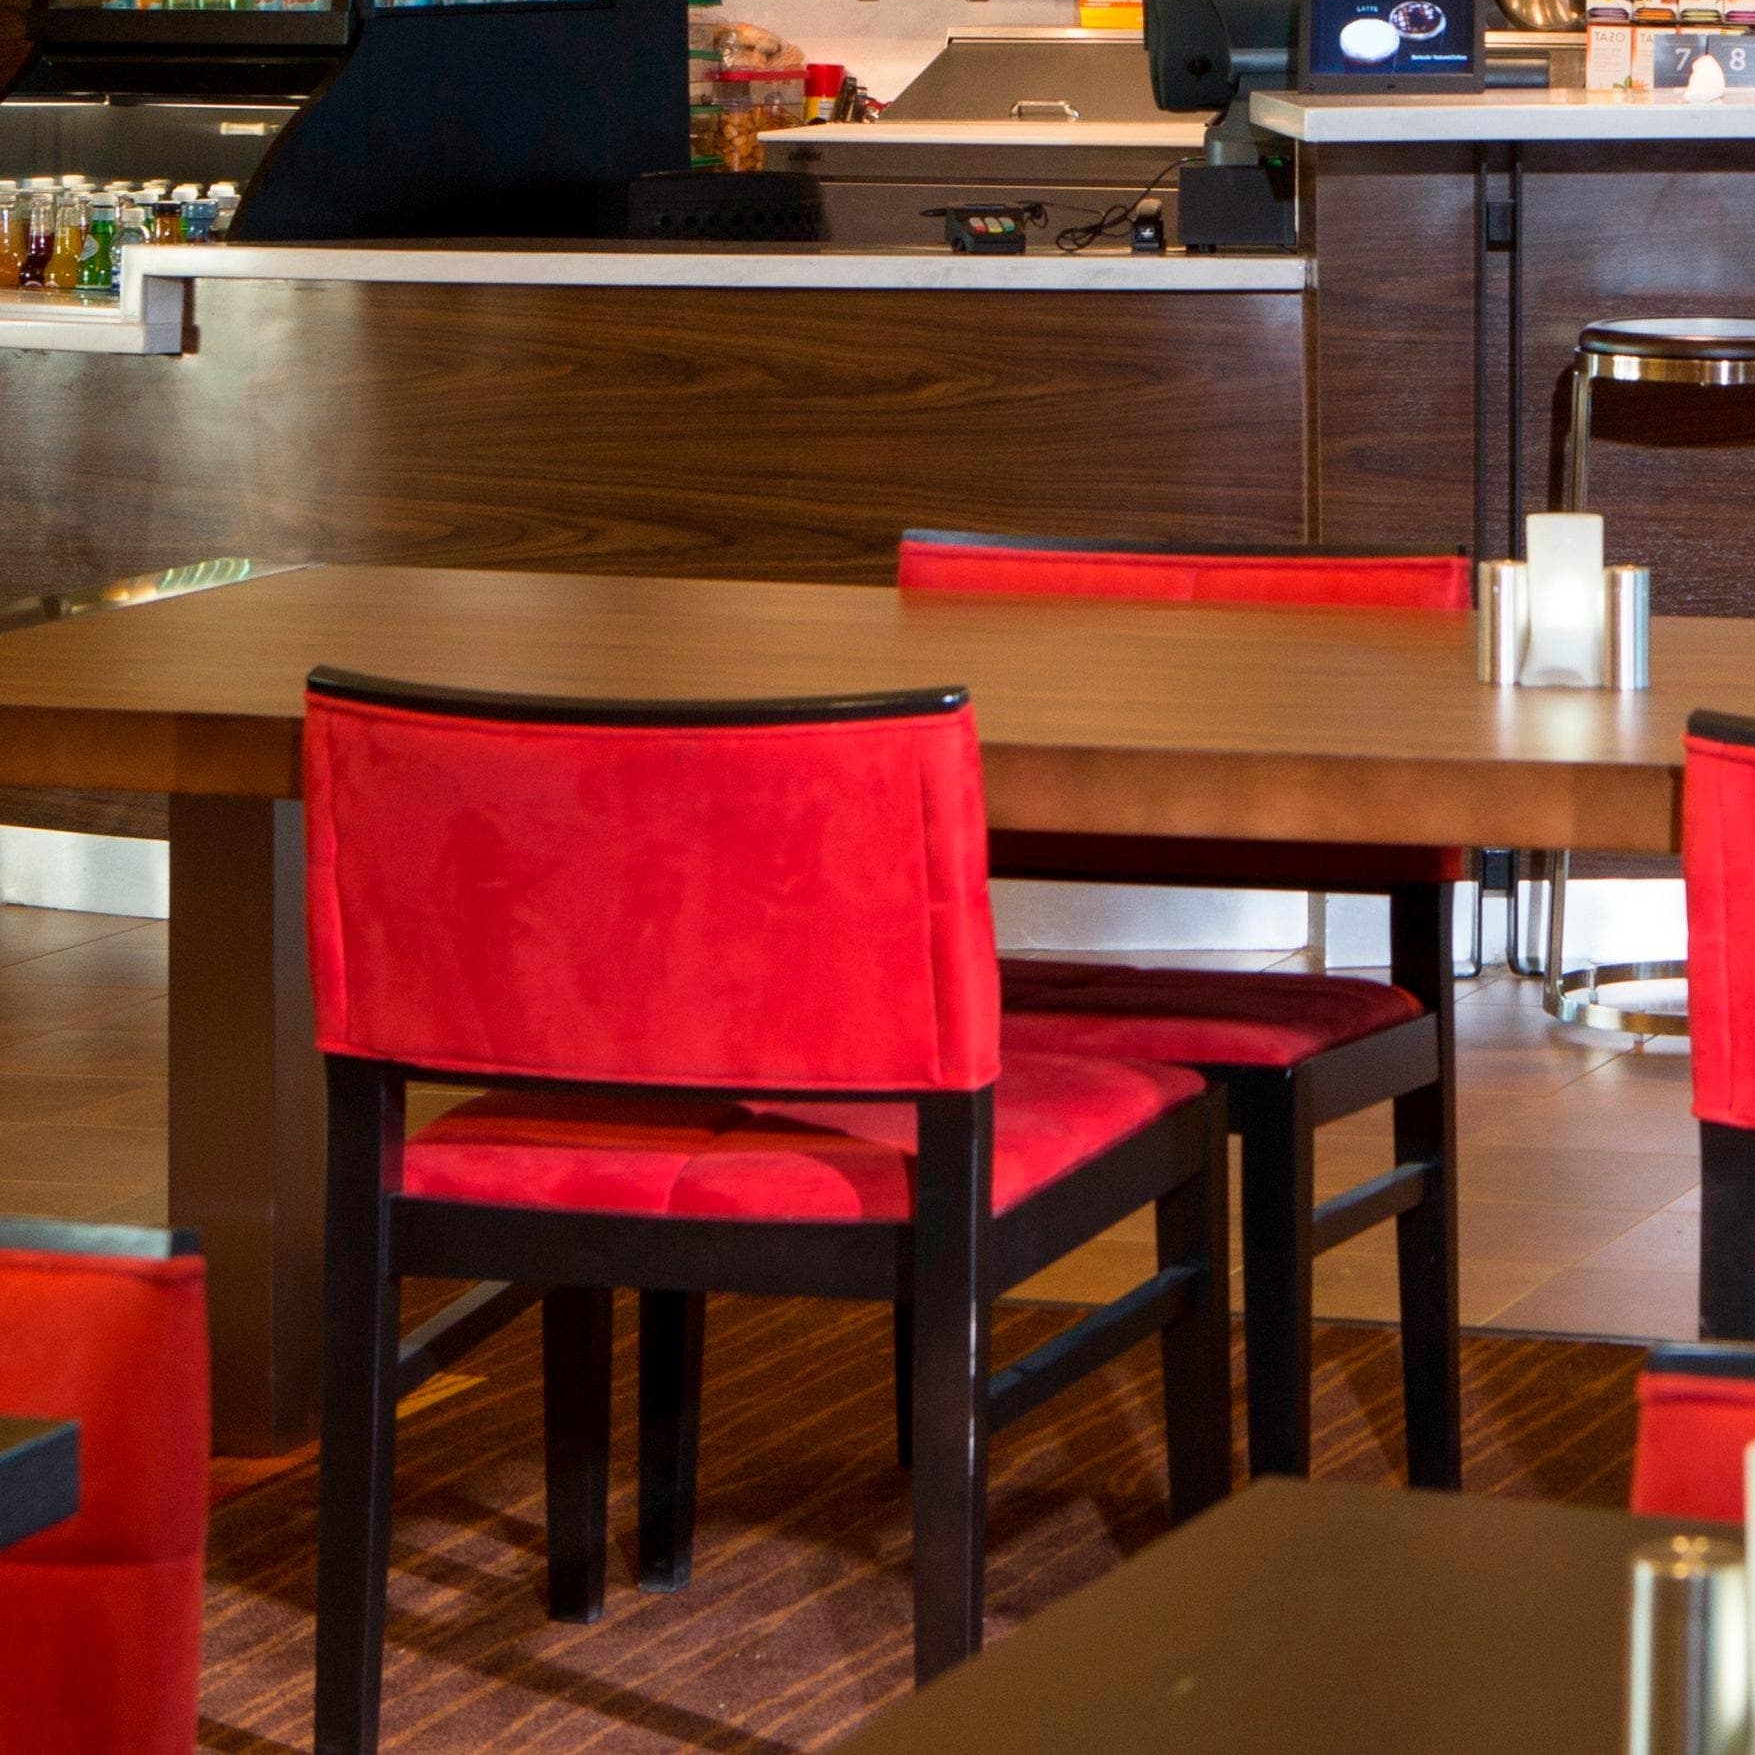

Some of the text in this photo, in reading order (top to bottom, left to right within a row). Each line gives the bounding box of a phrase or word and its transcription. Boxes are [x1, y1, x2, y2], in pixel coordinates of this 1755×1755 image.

[1357, 5, 1378, 13] LATTE
[1593, 31, 1626, 43] TAZO
[1639, 33, 1654, 43] TA
[1675, 48, 1691, 71] 7
[1729, 48, 1746, 71] 8
